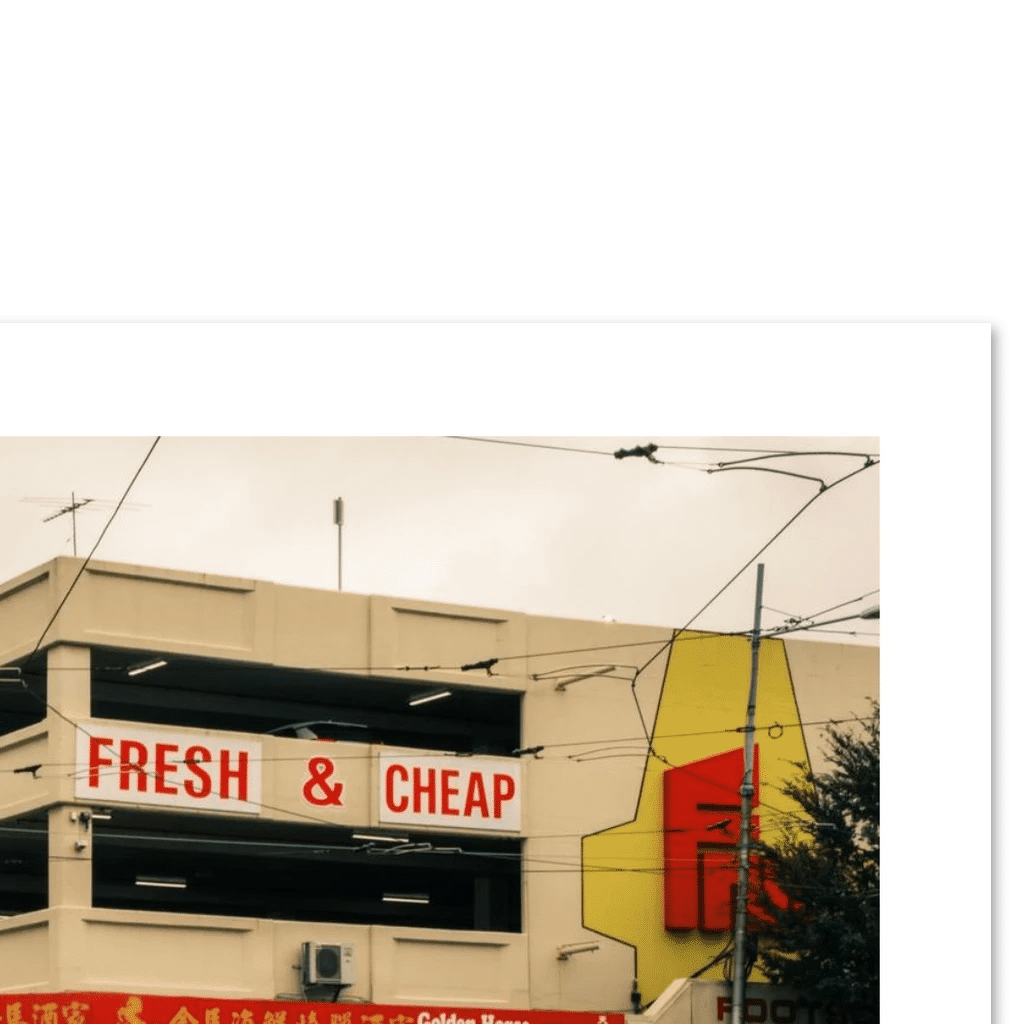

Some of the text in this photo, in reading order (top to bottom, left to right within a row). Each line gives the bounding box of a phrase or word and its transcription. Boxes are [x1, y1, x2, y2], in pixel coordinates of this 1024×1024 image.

[88, 736, 516, 820] FRESH & CHEAP
